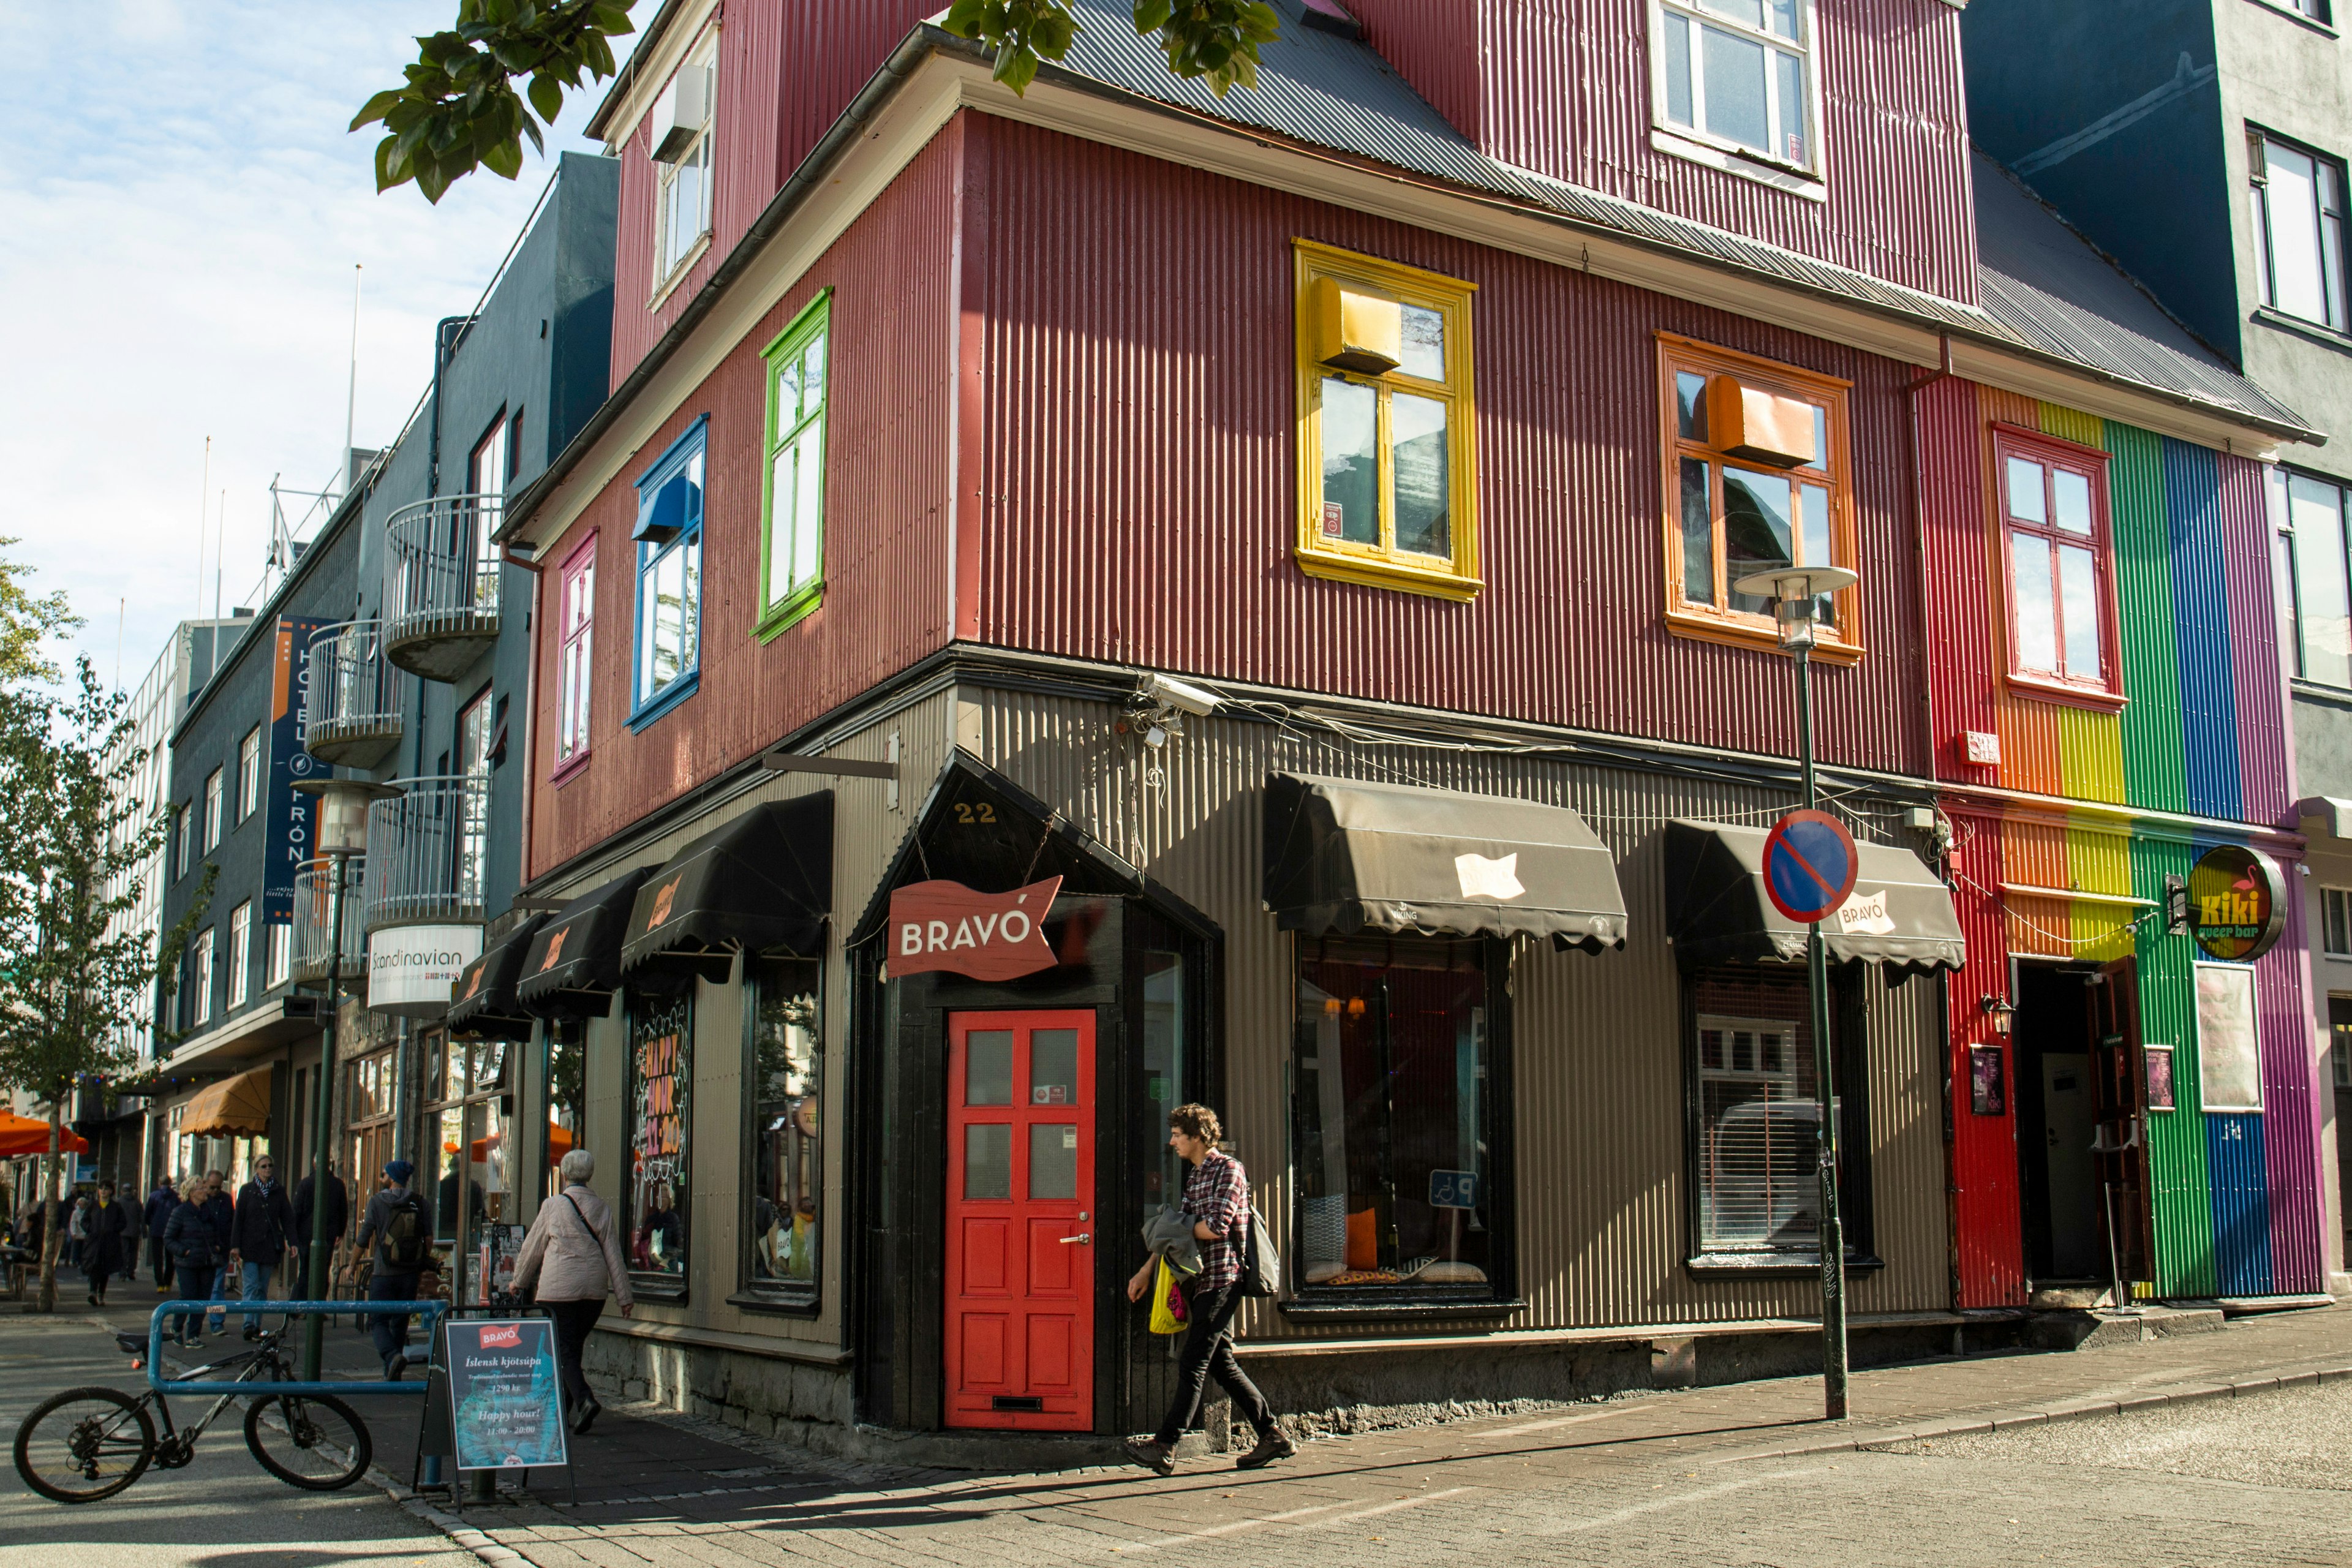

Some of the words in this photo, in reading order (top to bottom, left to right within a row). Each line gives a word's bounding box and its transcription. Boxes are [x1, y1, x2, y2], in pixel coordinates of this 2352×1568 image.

[954, 802, 997, 823] 22
[288, 790, 305, 861] FRÓN
[1842, 899, 1883, 923] BRAVÓ
[2199, 891, 2259, 925] Kiki
[901, 894, 1030, 956] BRAVÓ
[2198, 927, 2233, 941] queer
[2235, 925, 2259, 938] bar
[373, 949, 462, 970] Scandinavian
[646, 1034, 678, 1079] HAPPY
[647, 1074, 674, 1117] HOUR
[483, 1328, 516, 1343] BRAVÓ
[466, 1355, 499, 1367] Íslensk
[501, 1356, 541, 1368] kjötsúpa
[478, 1411, 511, 1423] Happy
[513, 1409, 540, 1419] hour!
